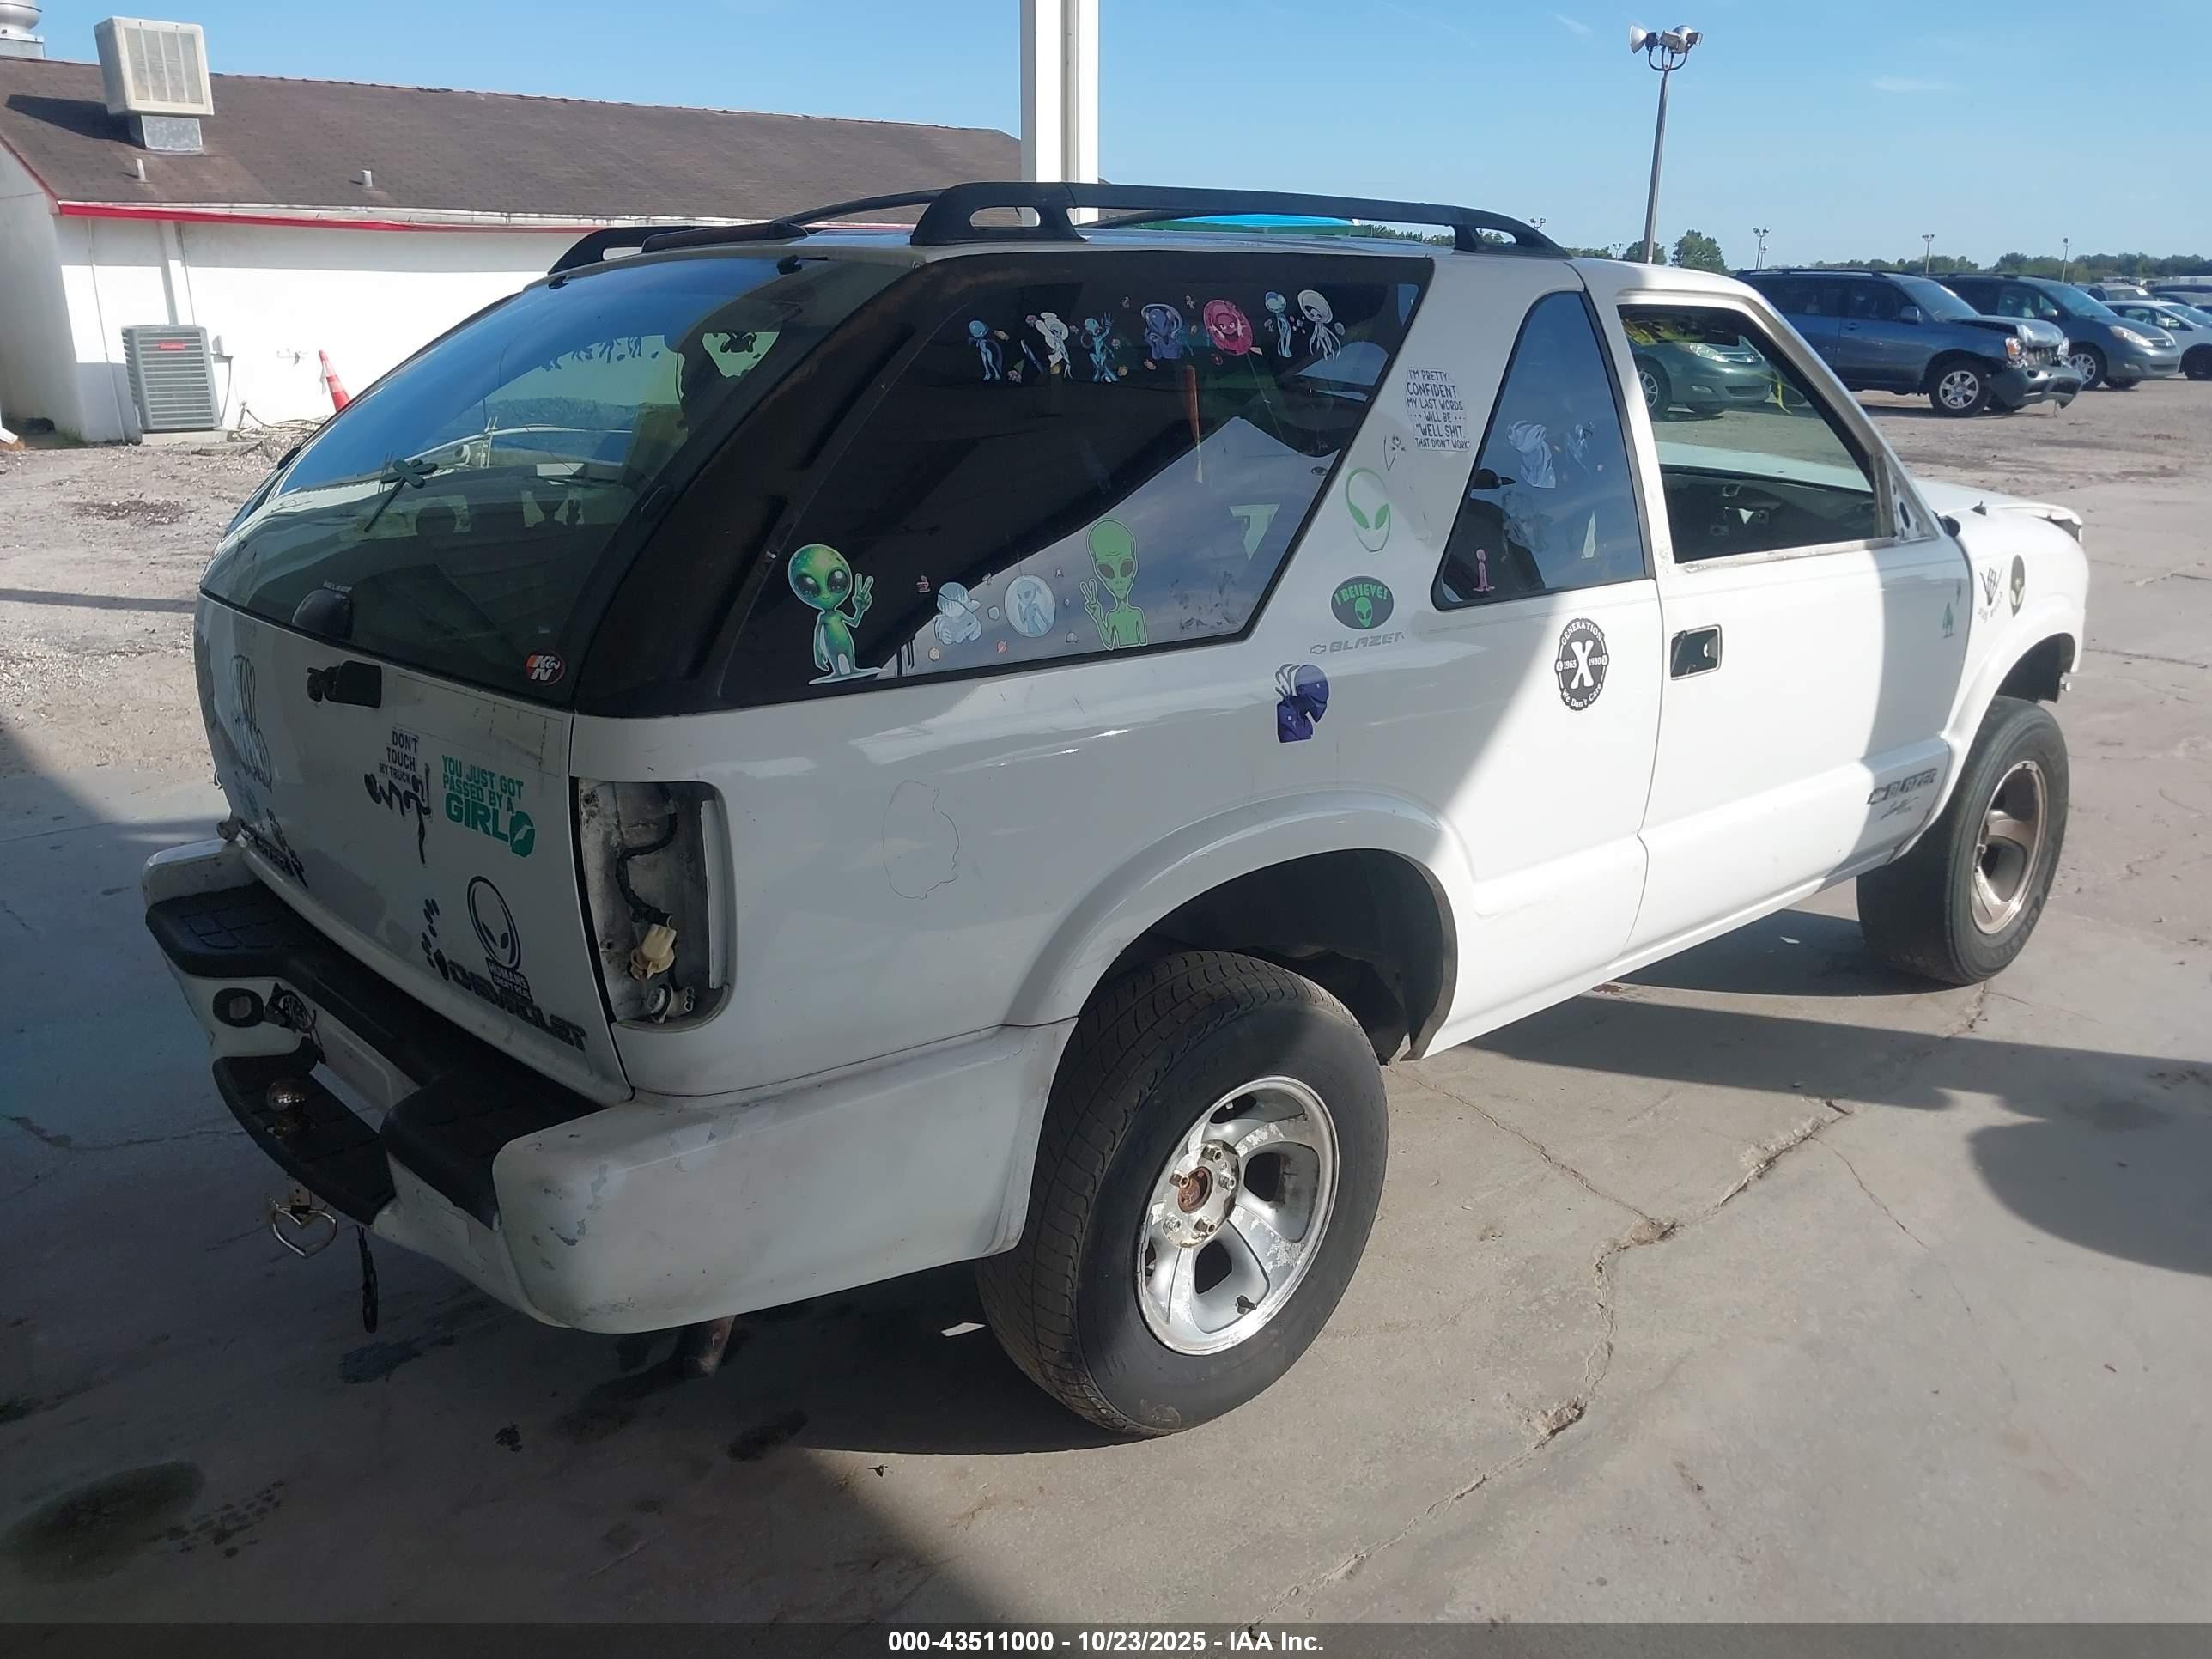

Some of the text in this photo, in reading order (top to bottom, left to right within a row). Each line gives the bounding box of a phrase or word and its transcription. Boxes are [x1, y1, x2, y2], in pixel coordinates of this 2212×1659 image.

[1408, 369, 1447, 381] I'M PRETTY
[1407, 381, 1457, 398] CONFIDENT
[1407, 398, 1463, 410] MY LAST WORDS
[1424, 410, 1452, 422] WILL BE
[1414, 437, 1431, 447] THAT
[1334, 583, 1389, 605] I BELIEVE!
[1329, 631, 1405, 653] BLAZER
[1561, 621, 1603, 645] GENERATION
[1570, 640, 1595, 690] X
[1588, 656, 1601, 666] 1980
[386, 746, 416, 772] TOUCH
[379, 762, 411, 784] MY TRUCK
[441, 754, 524, 799] YOU JUST GOT
[442, 774, 514, 814] PASSED BY A
[445, 792, 509, 842] GIRL
